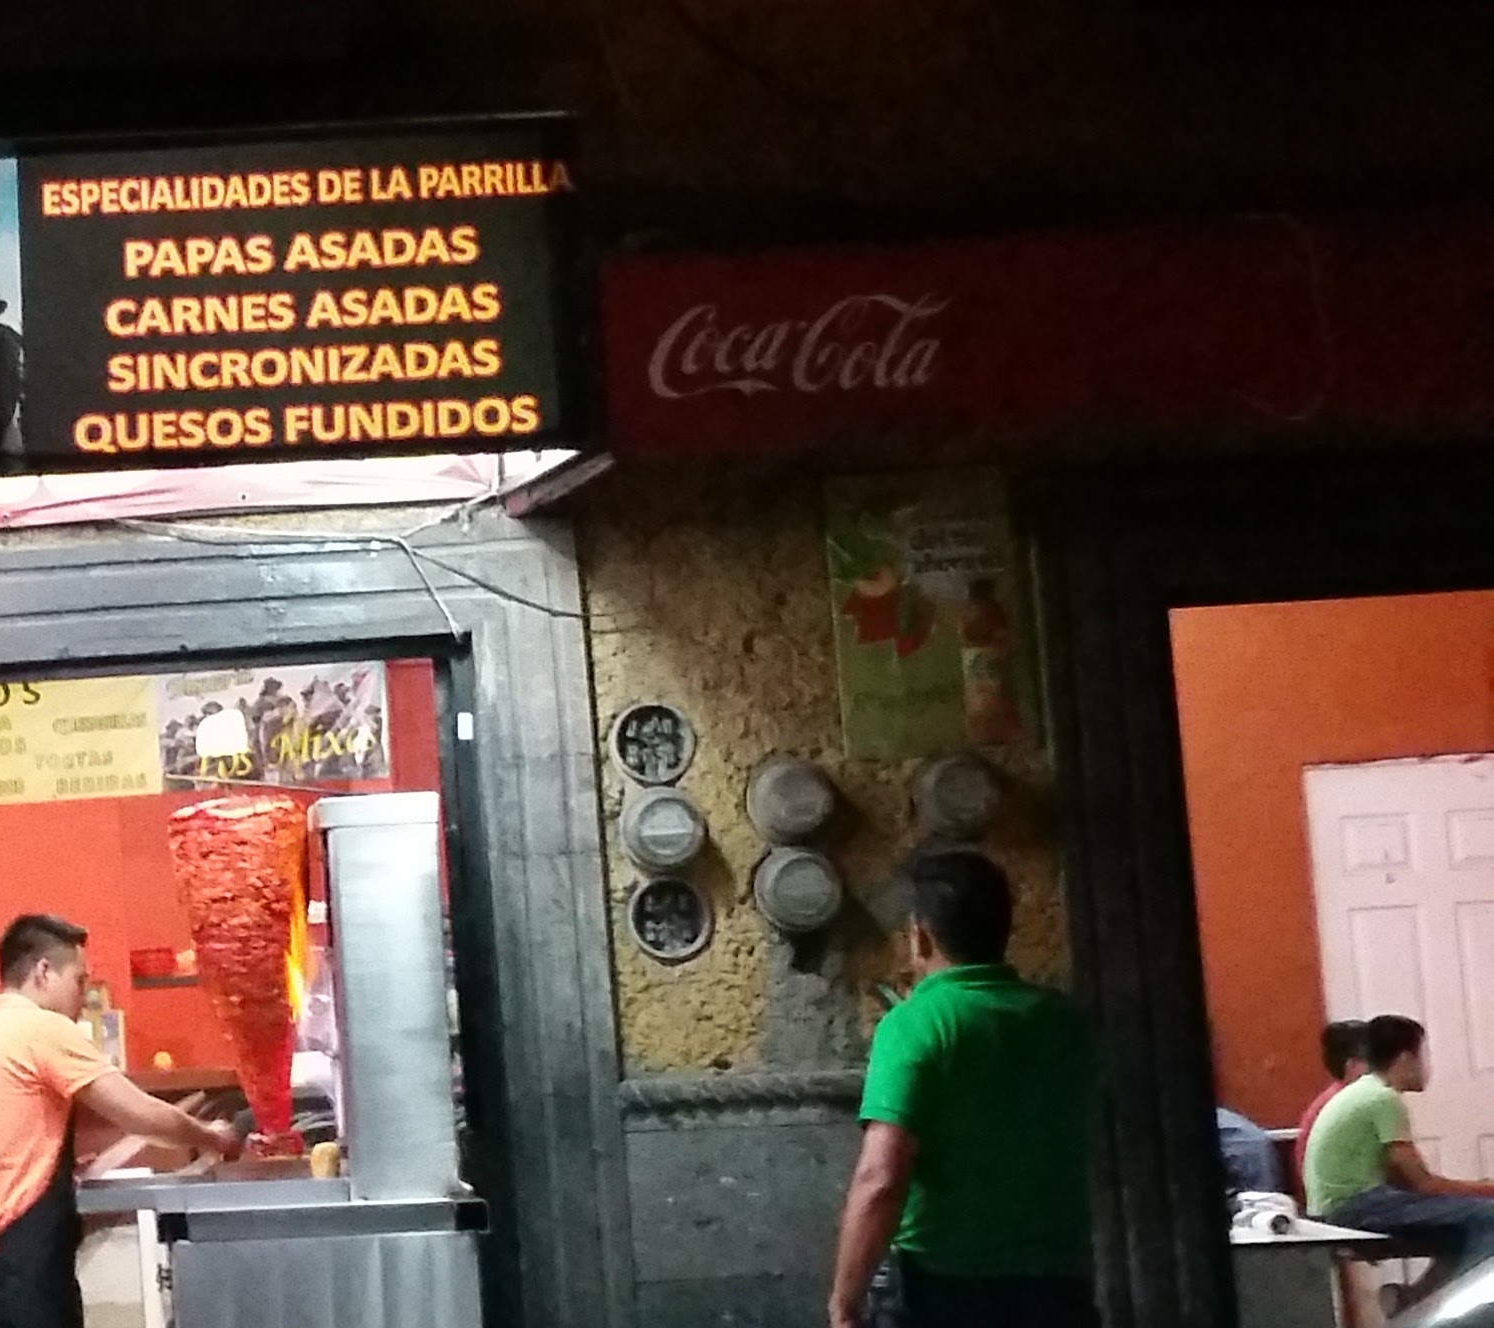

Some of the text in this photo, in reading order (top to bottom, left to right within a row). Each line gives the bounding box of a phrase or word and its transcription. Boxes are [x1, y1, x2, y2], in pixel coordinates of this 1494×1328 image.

[42, 161, 577, 216] ESPECIALIDADES DE LA PARRILLA
[124, 226, 479, 277] PAPAS ASADAS
[105, 283, 501, 336] CARNES ASADAS
[108, 339, 501, 393] SINCRONIZADAS
[74, 395, 540, 455] QUESOS FUNDIDOS
